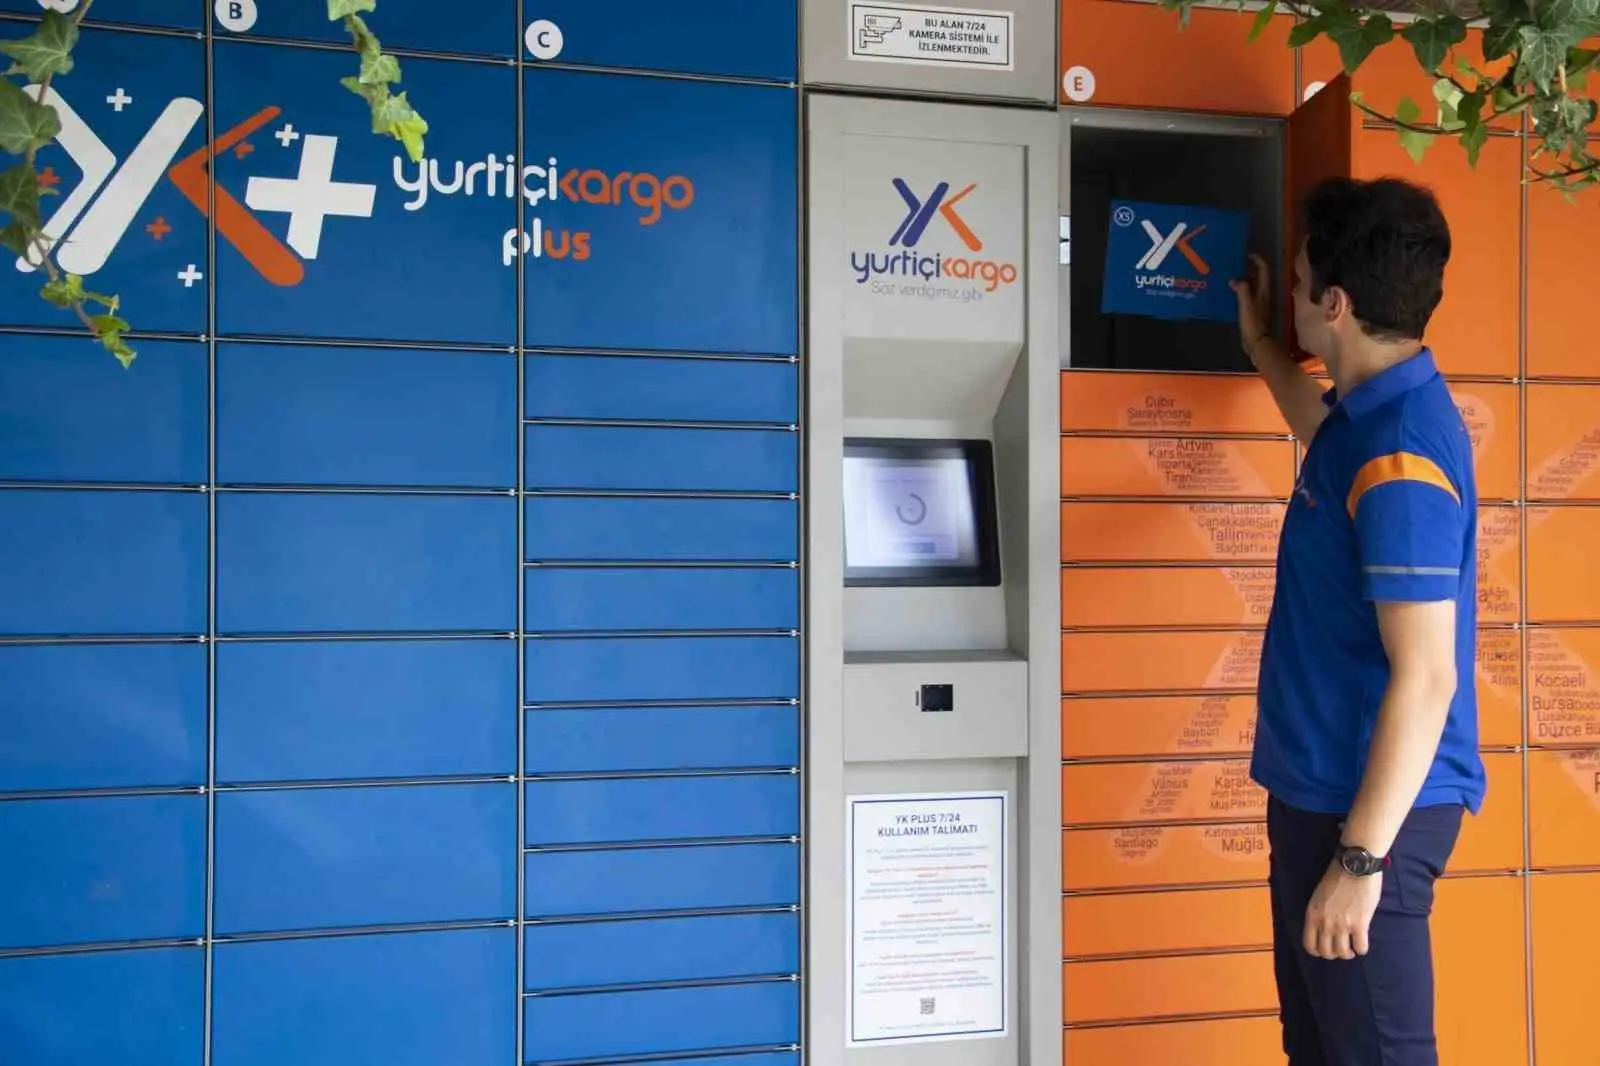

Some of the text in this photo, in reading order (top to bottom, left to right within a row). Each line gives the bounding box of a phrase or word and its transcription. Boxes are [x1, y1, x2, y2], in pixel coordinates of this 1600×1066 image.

[229, 2, 243, 19] B
[924, 18, 986, 31] BU ALAN 7/24
[537, 31, 550, 48] C
[909, 30, 947, 41] KAMERA
[1074, 76, 1083, 91] E
[393, 153, 694, 225] yurtiçikargo
[502, 217, 591, 266] plus
[851, 250, 1017, 292] yurtiçikargo
[1534, 672, 1585, 688] Kocaeli
[1533, 695, 1573, 710] Bursa
[895, 812, 960, 825] YK PLUS 7/24
[877, 826, 929, 837] KULLANIM
[1221, 838, 1265, 854] Muğla
